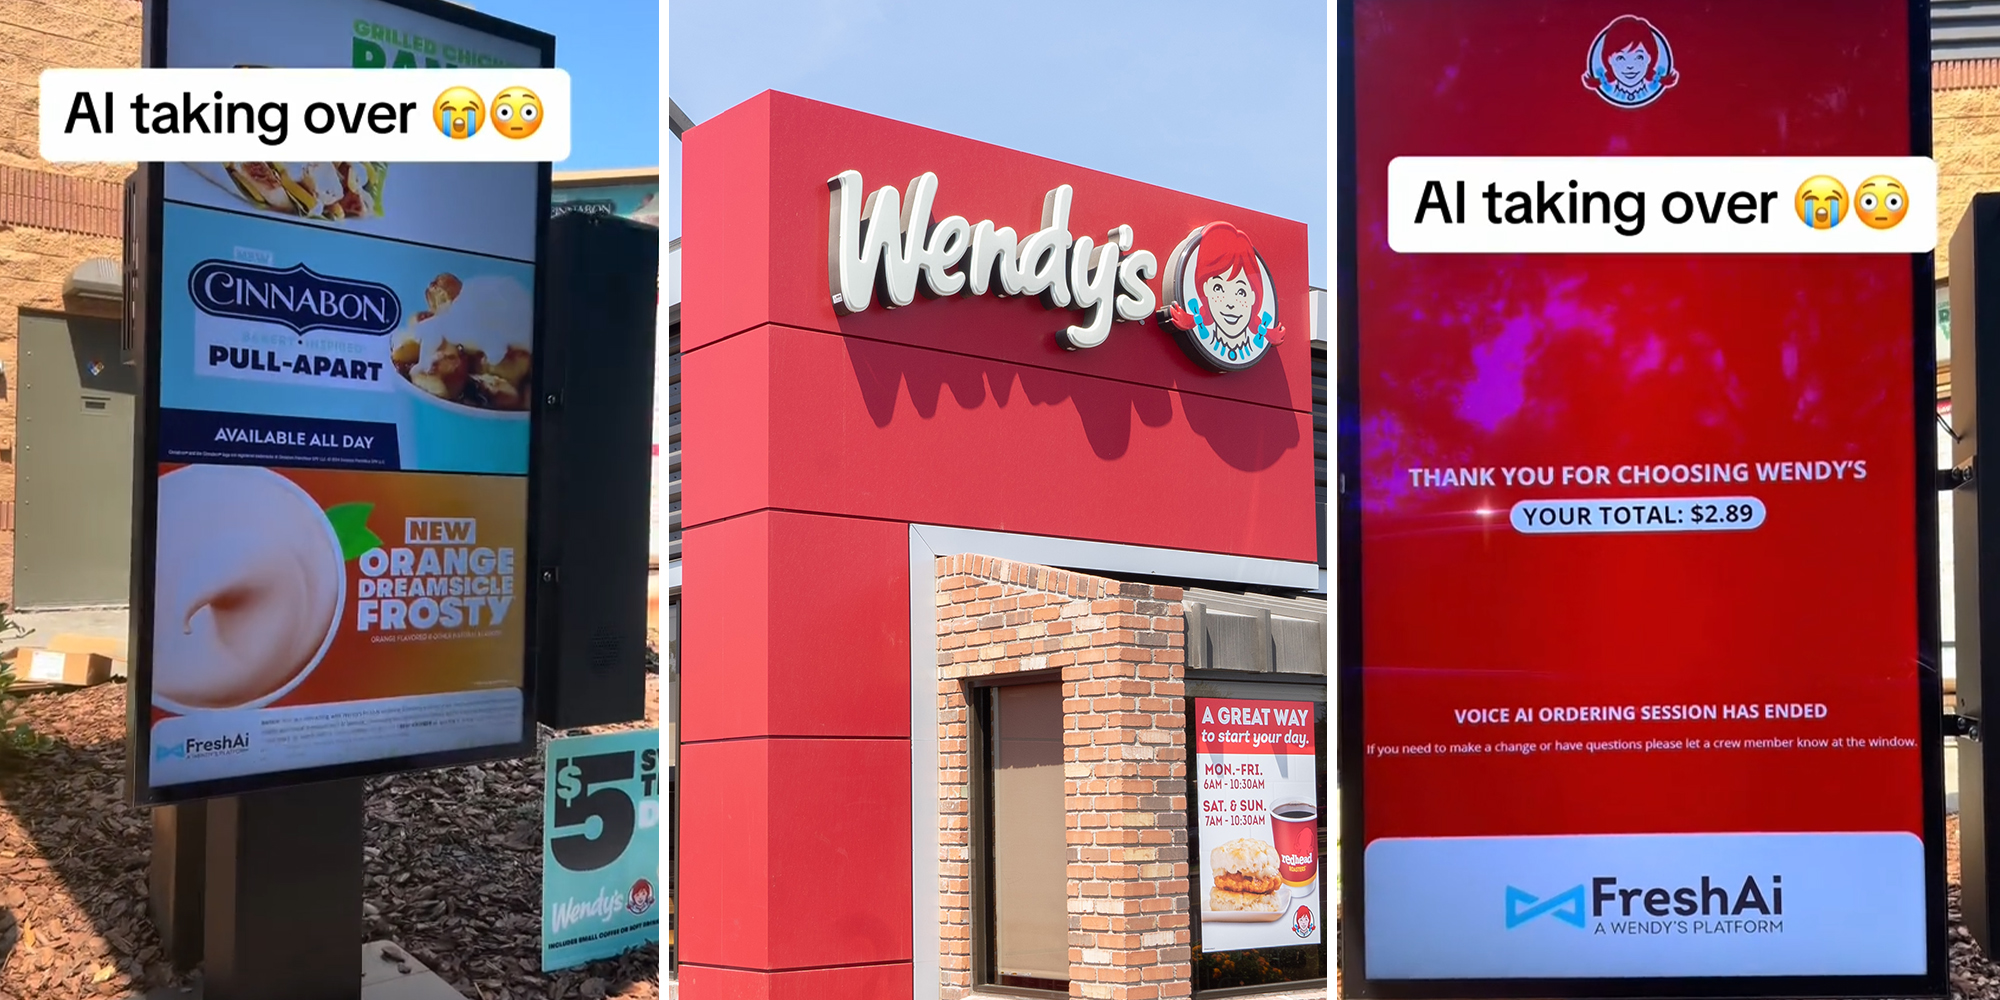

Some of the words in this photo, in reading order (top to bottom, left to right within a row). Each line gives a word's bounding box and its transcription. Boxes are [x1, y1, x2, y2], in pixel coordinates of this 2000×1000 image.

[353, 19, 437, 57] GRILLED
[827, 169, 1157, 350] Wendy's
[204, 271, 390, 324] CINNABON
[209, 345, 383, 381] PULL-APART
[214, 427, 306, 446] AVAILABLE
[309, 433, 339, 447] ALL
[342, 434, 375, 449] DAY
[1408, 467, 1496, 488] THANK
[1501, 466, 1554, 487] YOU
[1562, 465, 1611, 485] FOR
[1616, 463, 1749, 484] CHOOSING
[1754, 460, 1868, 482] WENDY'S
[1522, 506, 1593, 527] YOUR
[1600, 505, 1684, 526] TOTAL:
[1690, 503, 1754, 525] $2.89
[410, 521, 471, 541] NEW
[359, 547, 514, 577] ORANGE
[358, 576, 514, 598] DREAMSICLE
[357, 596, 515, 632] FROSTY
[1201, 706, 1214, 724] A
[1217, 706, 1271, 726] GREAT
[1273, 708, 1309, 727] WAY
[1454, 708, 1510, 724] VOICE
[1515, 707, 1533, 723] AI
[1538, 705, 1636, 722] ORDERING
[1641, 704, 1717, 720] SESSION
[1722, 703, 1759, 719] HAS
[1765, 703, 1828, 719] ENDED
[186, 732, 249, 753] FreshAi
[1201, 729, 1215, 742] to
[1218, 730, 1250, 743] start
[1253, 733, 1282, 748] your
[1284, 729, 1309, 748] day.
[1367, 743, 1376, 754] If
[1377, 745, 1399, 757] you
[1402, 742, 1431, 754] need
[1434, 743, 1446, 753] to
[1450, 742, 1481, 753] make
[1484, 744, 1491, 752] a
[1494, 741, 1536, 755] change
[1540, 742, 1552, 751] or
[1555, 740, 1583, 751] have
[1586, 739, 1642, 753] questions
[1645, 738, 1683, 752] please
[1685, 738, 1700, 749] let
[1703, 740, 1710, 749] a
[1713, 739, 1741, 748] crew
[1744, 737, 1793, 748] member
[1797, 736, 1828, 747] know
[1832, 737, 1843, 747] at
[1846, 736, 1866, 747] the
[1868, 736, 1918, 747] window.
[1205, 764, 1263, 775] MON.-FRI.
[1203, 779, 1222, 789] 6AM
[1230, 779, 1265, 789] 10:30AM
[1203, 800, 1227, 812] SAT.
[1230, 800, 1237, 812] &
[1240, 800, 1267, 811] SUN.
[1205, 816, 1222, 826] 7AM
[1231, 815, 1266, 826] 10:30AM
[1281, 852, 1313, 866] redhead
[1592, 875, 1783, 917] FreshAi
[551, 886, 624, 934] Wendy's
[548, 938, 578, 950] INCLUDES
[578, 934, 598, 943] SMALL
[598, 930, 620, 939] COFFEE
[629, 923, 642, 931] SOFT
[1594, 922, 1606, 935] A
[1610, 920, 1688, 935] WENDY'S
[1693, 919, 1783, 934] PLATFORM
